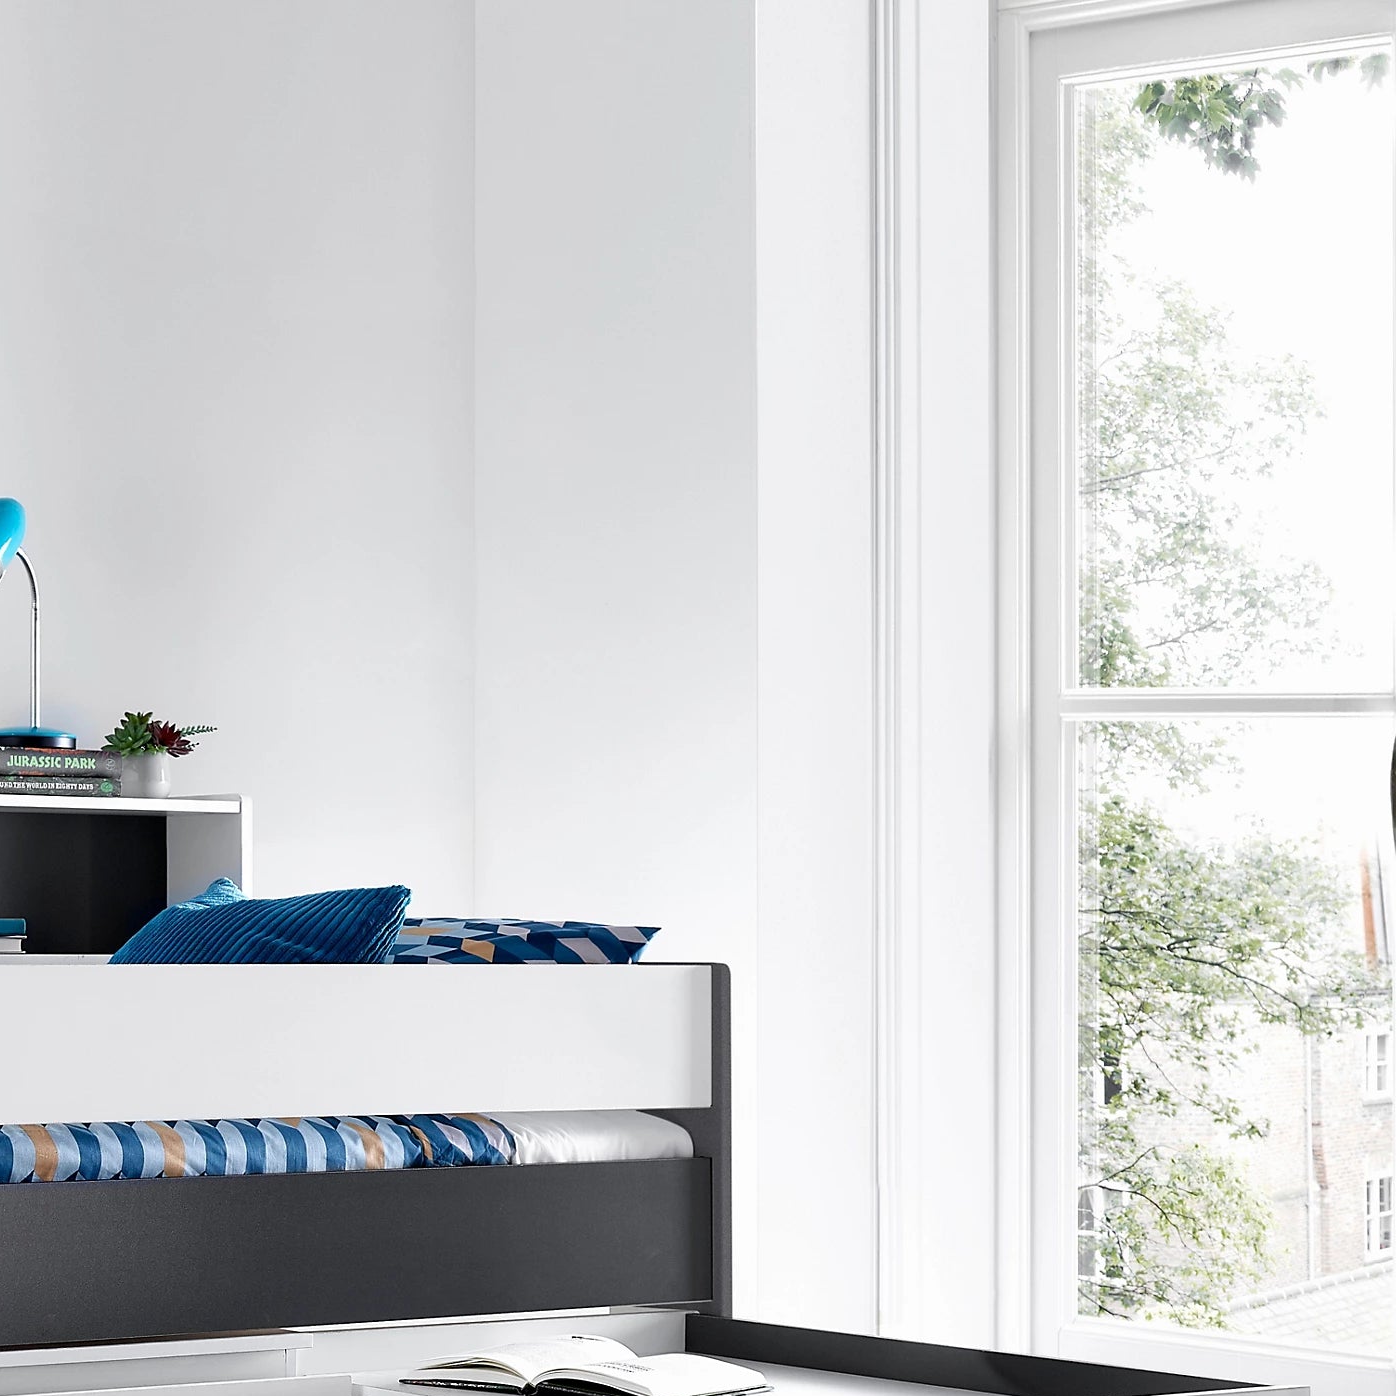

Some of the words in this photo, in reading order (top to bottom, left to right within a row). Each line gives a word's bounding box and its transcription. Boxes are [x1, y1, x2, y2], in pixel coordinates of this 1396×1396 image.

[7, 755, 62, 768] JURASSIC
[65, 757, 96, 769] PARK
[12, 781, 25, 789] THE
[25, 782, 47, 790] WORLD
